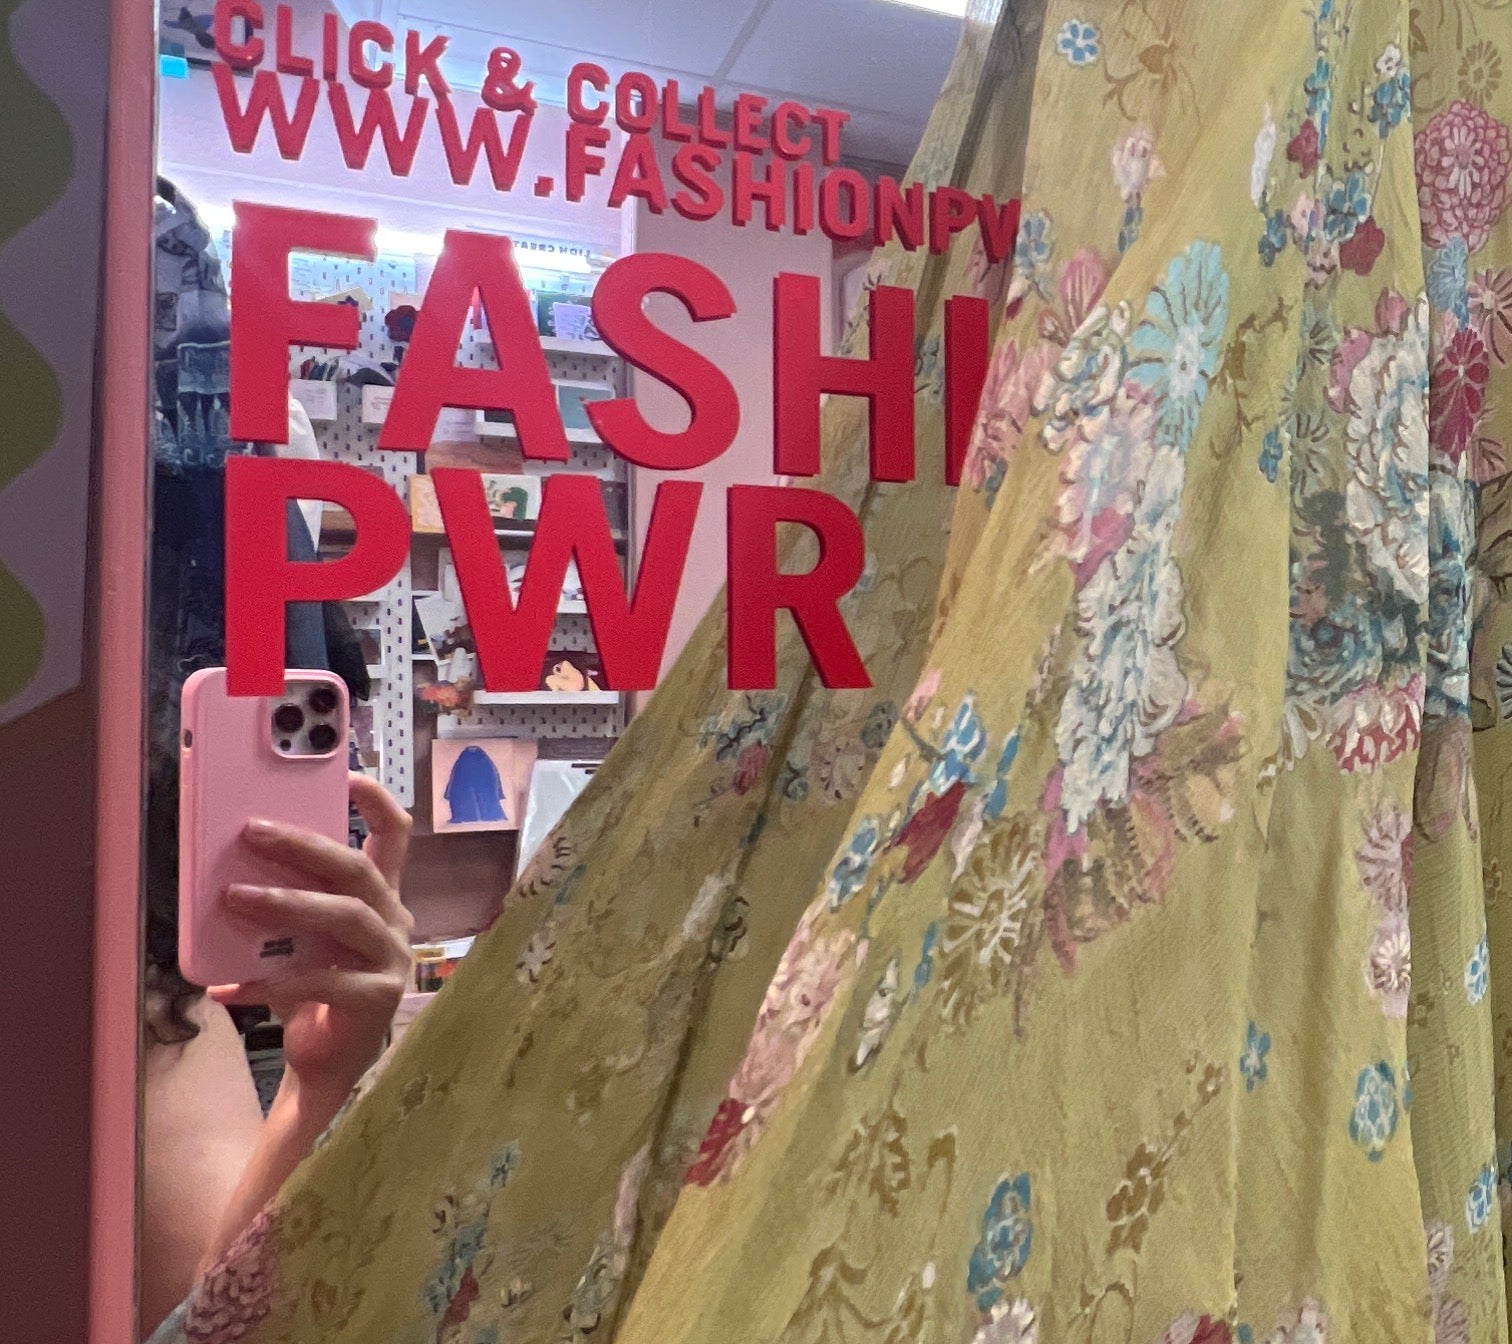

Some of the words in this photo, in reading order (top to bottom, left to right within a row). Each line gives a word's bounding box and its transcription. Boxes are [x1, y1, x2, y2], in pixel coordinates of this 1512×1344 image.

[481, 46, 538, 117] &
[566, 62, 851, 167] COLLECT
[229, 199, 989, 487] FASHI
[224, 456, 874, 697] PWR
